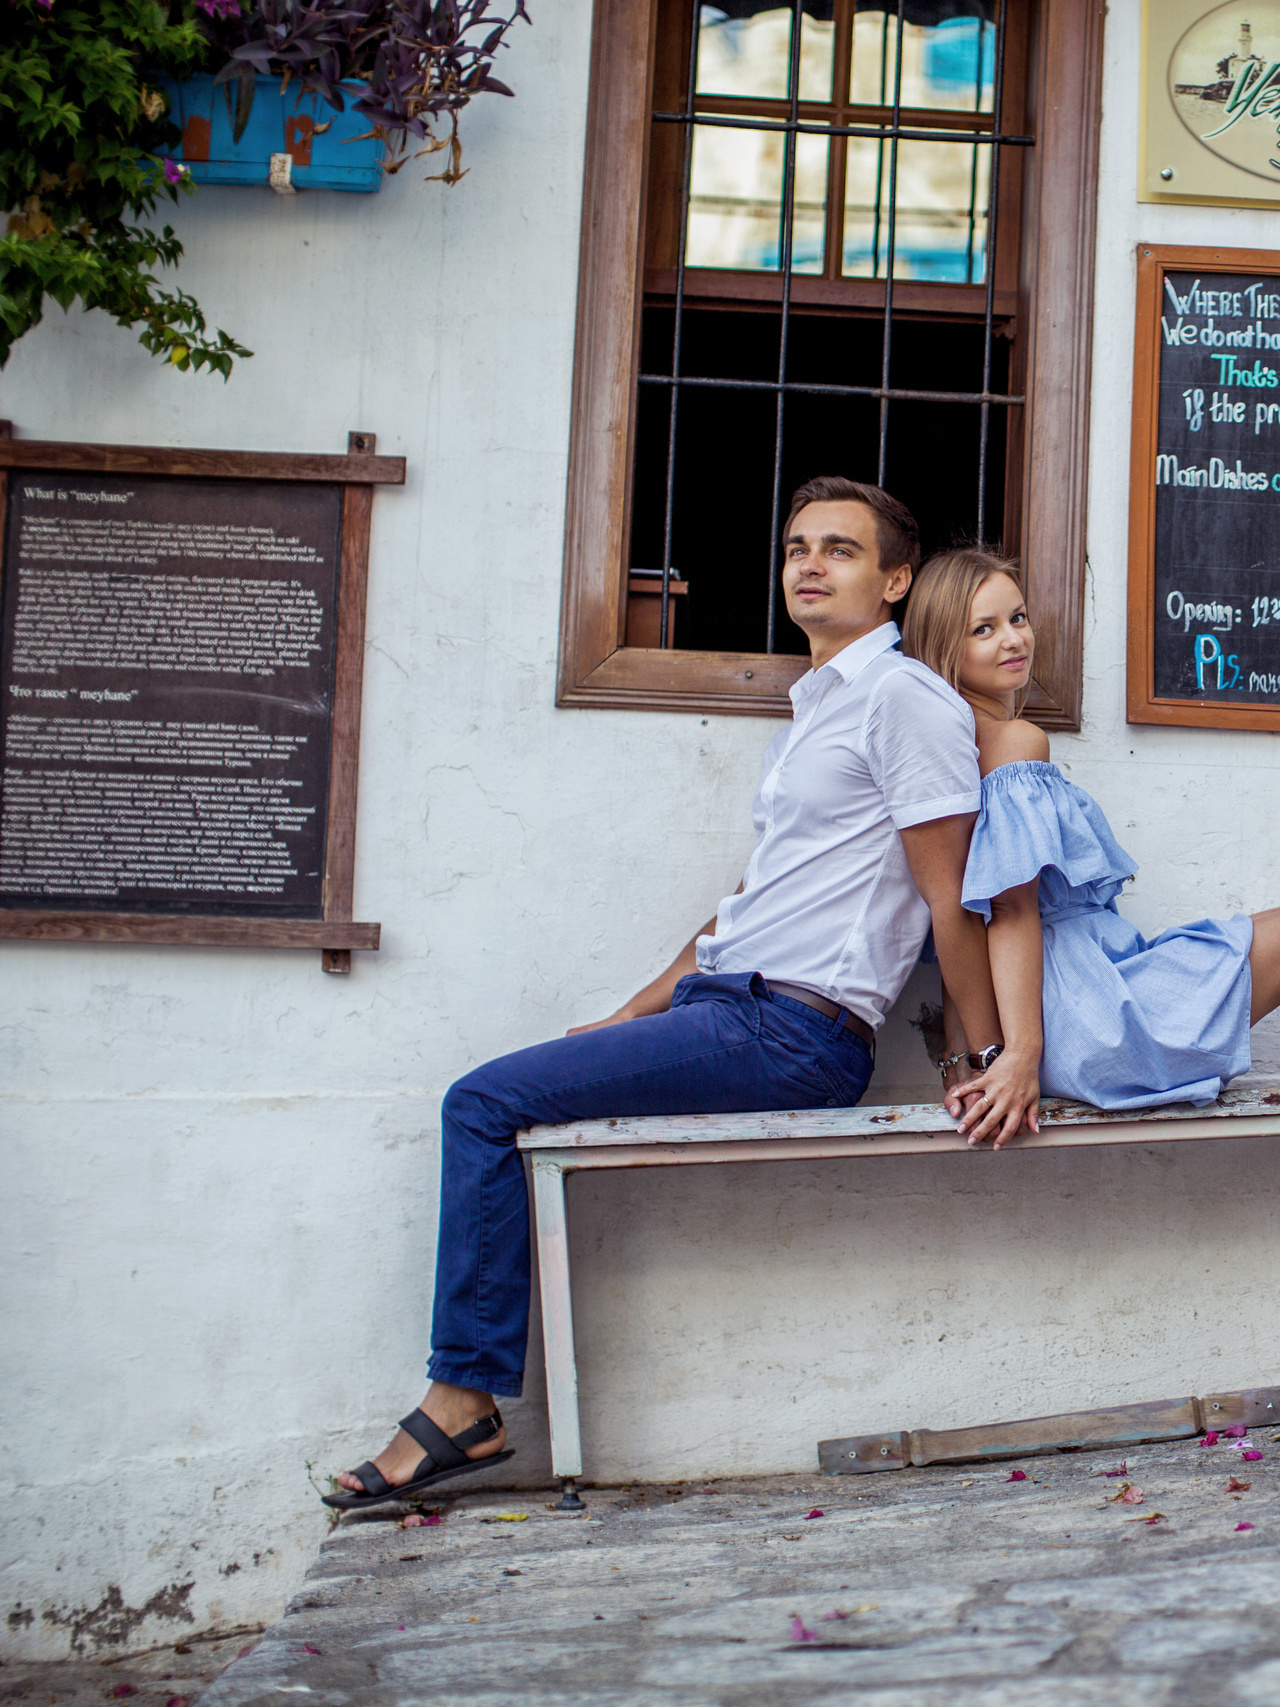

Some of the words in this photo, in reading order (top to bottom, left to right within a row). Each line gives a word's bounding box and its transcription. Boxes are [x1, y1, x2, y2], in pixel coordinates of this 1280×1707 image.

[1164, 276, 1244, 317] WHERE
[1161, 316, 1198, 346] We
[1209, 391, 1247, 423] the
[1156, 454, 1209, 487] Main
[1209, 457, 1269, 491] Dishes
[22, 487, 54, 499] What
[56, 488, 67, 500] is
[68, 517, 101, 527] composed
[28, 524, 60, 534] meyhane
[75, 526, 109, 535] traditional
[111, 528, 136, 536] Turkish
[137, 529, 170, 537] restaurant
[171, 530, 192, 538] where
[193, 531, 224, 540] alcoholic
[225, 533, 259, 543] beverages
[260, 534, 276, 542] such
[83, 544, 115, 554] alongside
[139, 547, 155, 555] until
[156, 547, 167, 555] the
[168, 548, 181, 556] late
[198, 549, 224, 559] century
[225, 550, 244, 558] when
[245, 551, 258, 559] raki
[259, 552, 297, 561] established
[298, 553, 315, 561] itself
[94, 536, 106, 544] and
[136, 538, 158, 546] served
[160, 539, 178, 548] along
[179, 540, 194, 548] with
[195, 541, 230, 549] traditional
[256, 543, 290, 553] Meyhanes
[76, 553, 104, 561] national
[104, 554, 123, 562] drink
[66, 570, 90, 579] brandy
[191, 575, 223, 584] flavoured
[241, 577, 269, 587] pungent
[92, 580, 108, 588] with
[167, 583, 182, 591] with
[184, 584, 206, 592] snacks
[244, 586, 264, 594] Some
[297, 589, 315, 597] drink
[1166, 590, 1243, 633] Opening:
[8, 684, 31, 697] Что
[33, 688, 67, 698] такое
